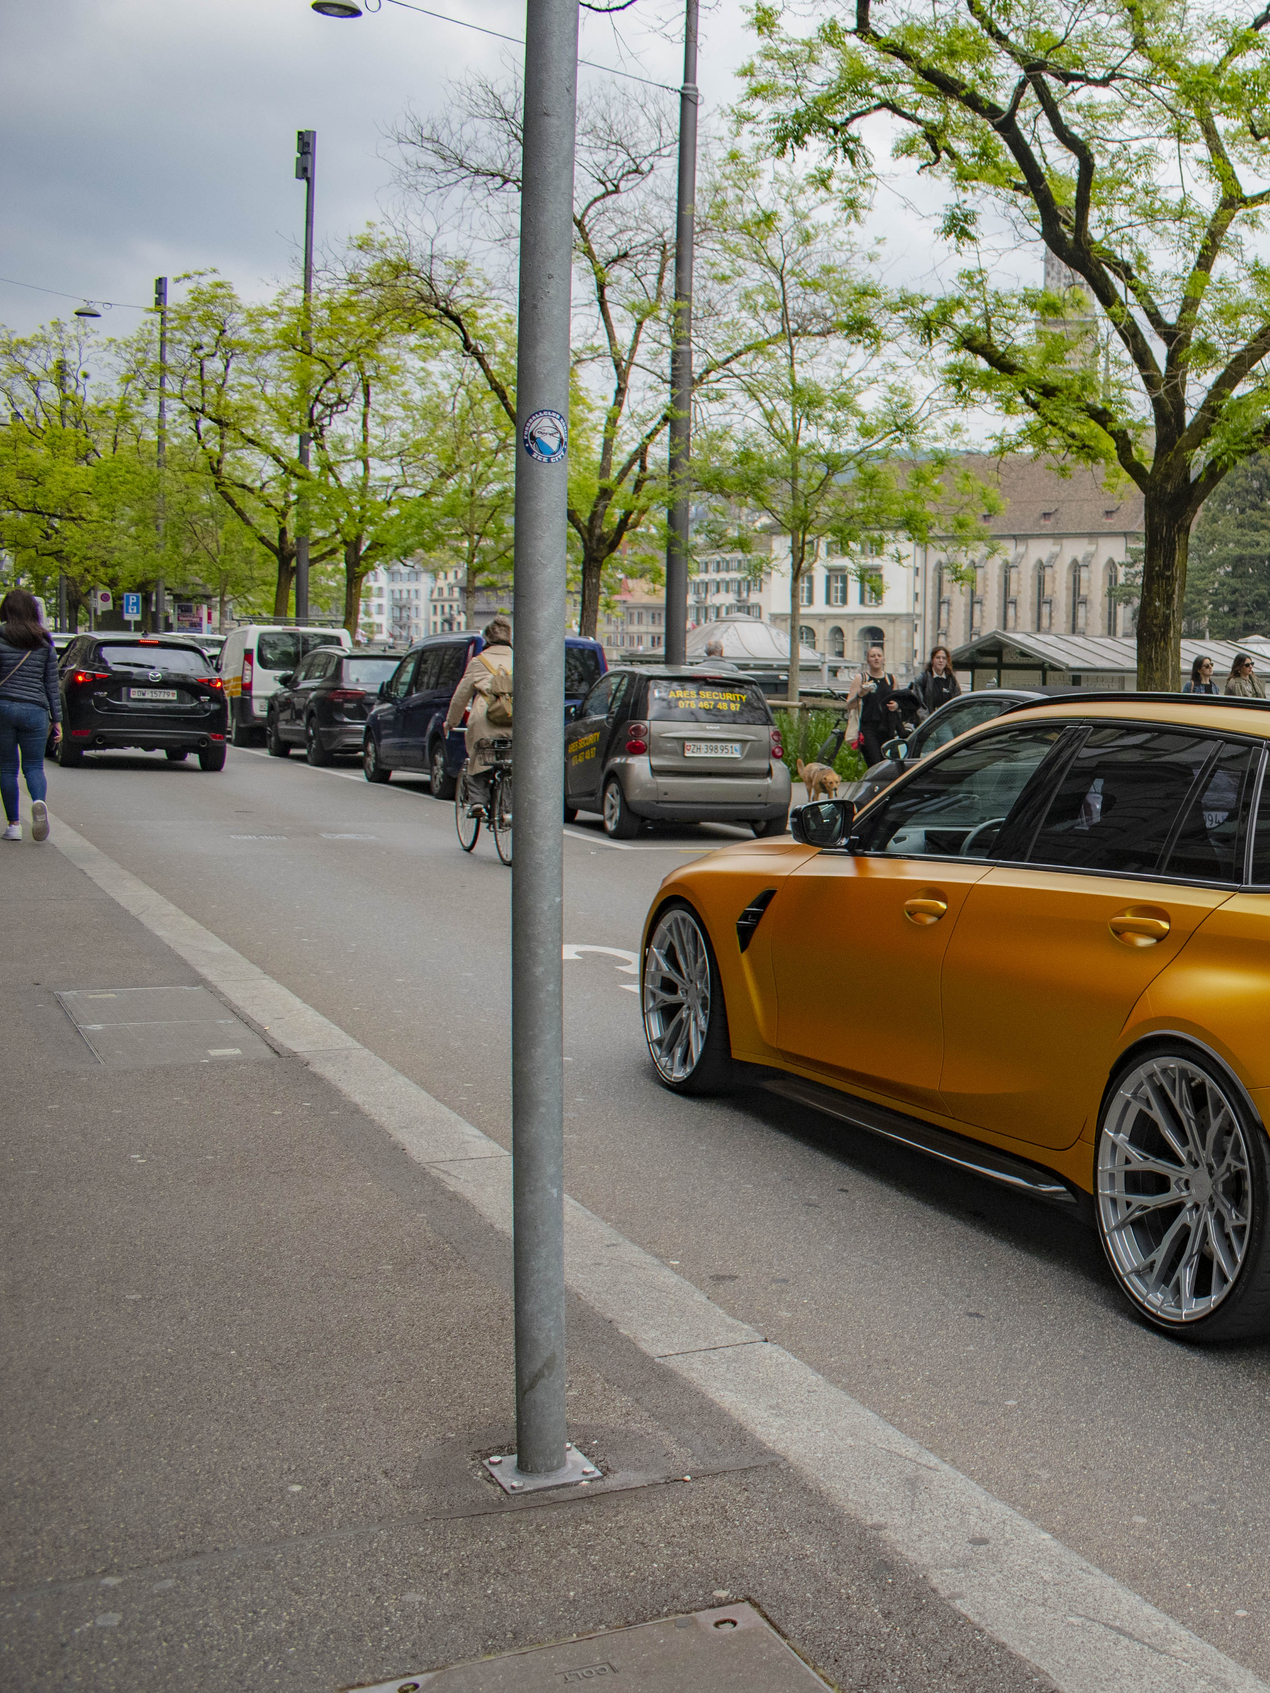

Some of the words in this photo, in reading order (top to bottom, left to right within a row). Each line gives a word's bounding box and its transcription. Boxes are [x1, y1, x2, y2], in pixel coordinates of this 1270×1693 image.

[551, 452, 565, 462] CITY
[129, 595, 137, 605] P
[668, 690, 697, 699] ARES
[699, 690, 747, 702] SECURITY
[678, 700, 696, 709] 076
[698, 701, 714, 709] 467
[717, 702, 728, 710] 48
[730, 703, 741, 711] 87
[563, 1665, 609, 1684] COLT
